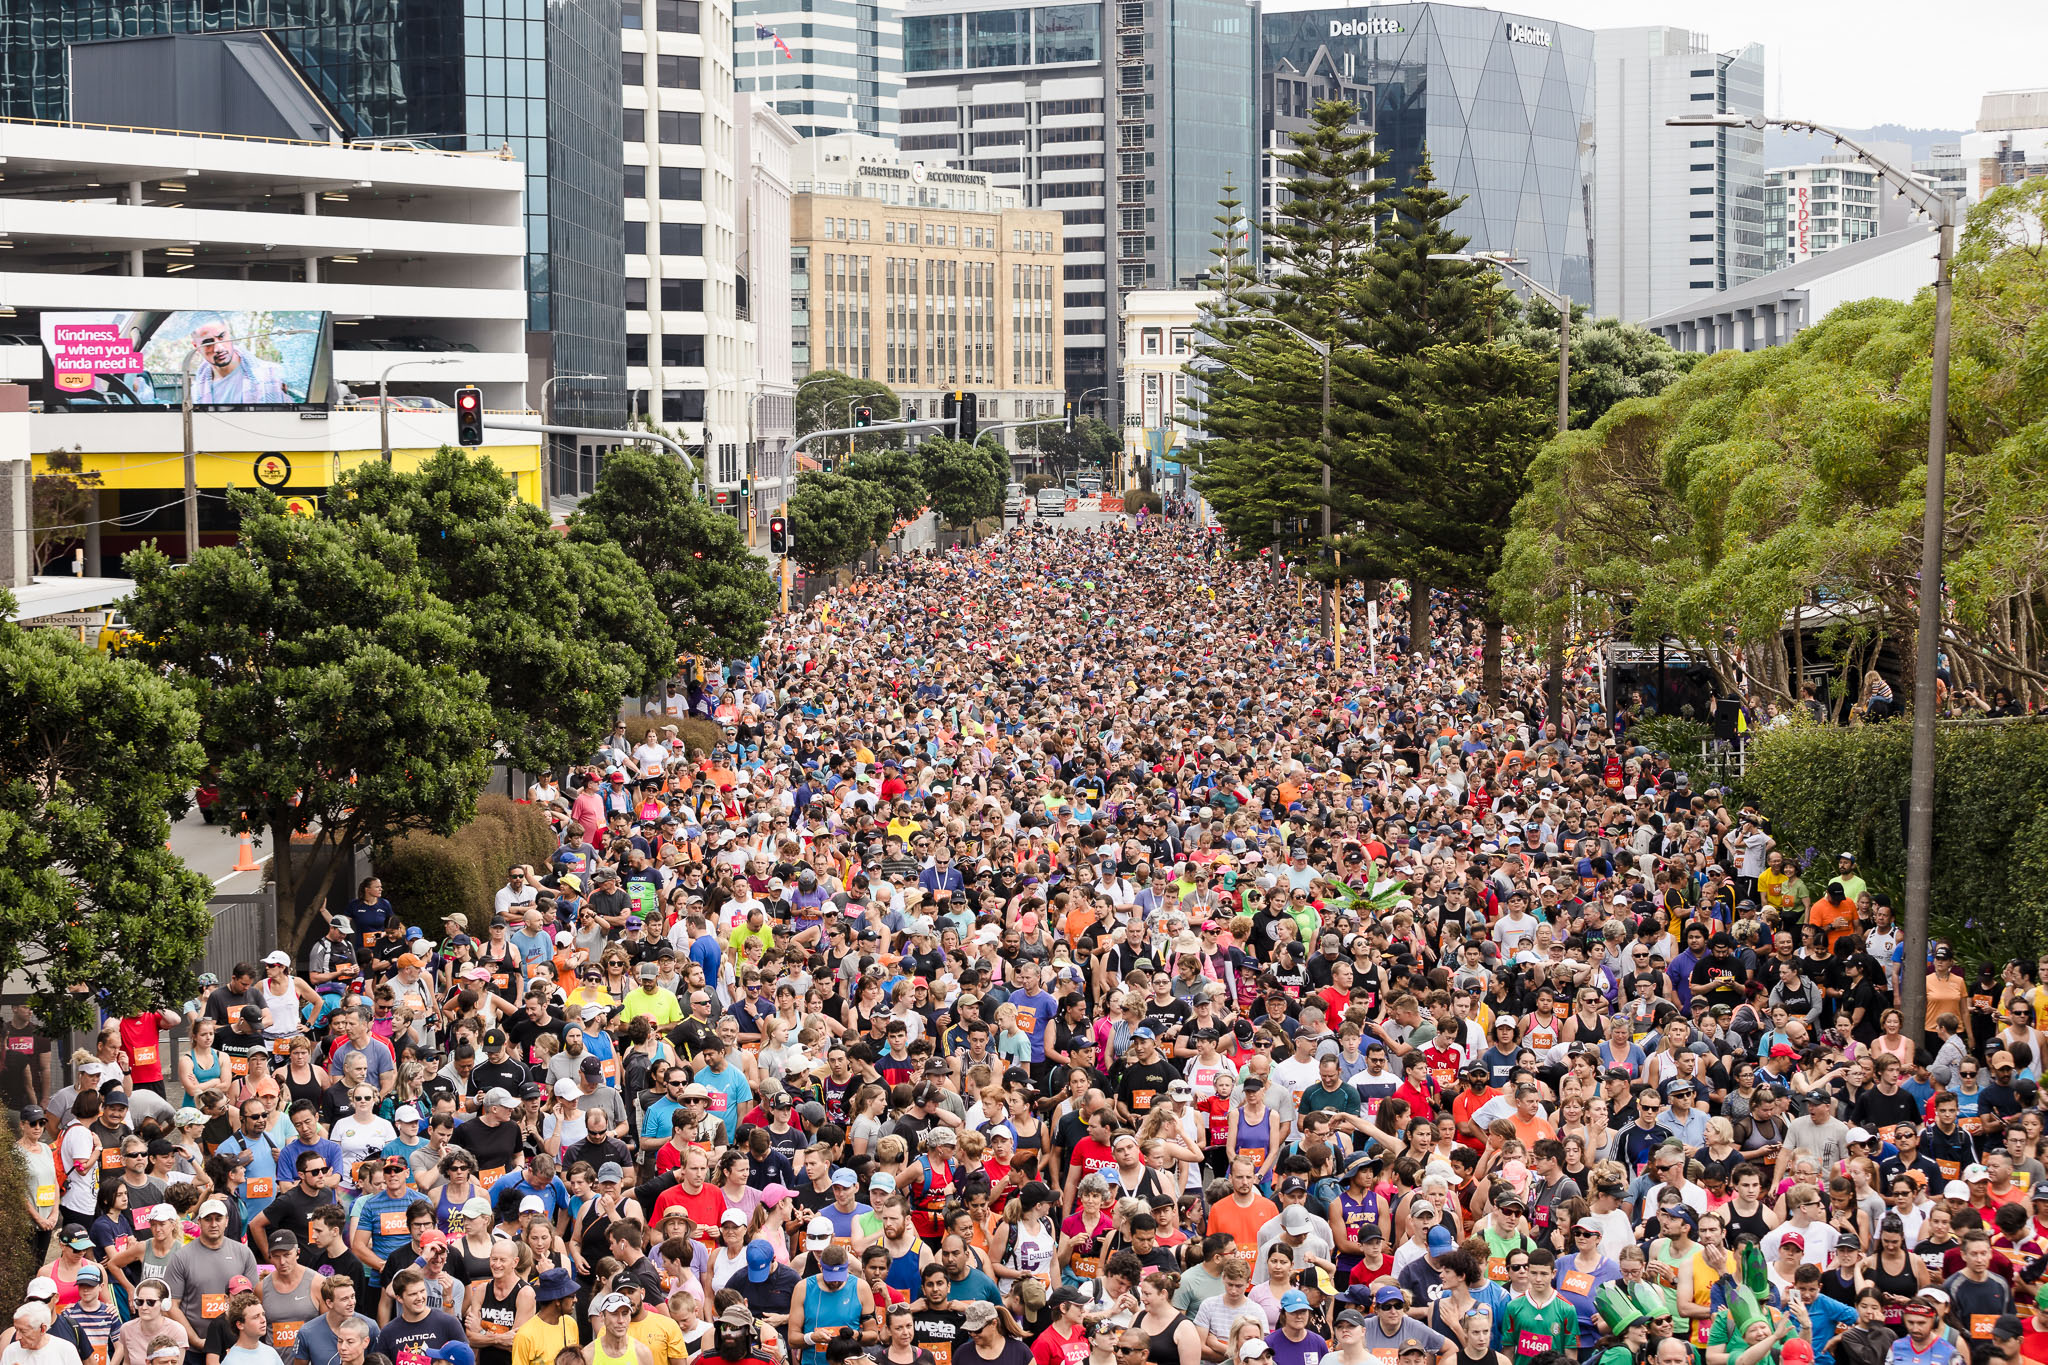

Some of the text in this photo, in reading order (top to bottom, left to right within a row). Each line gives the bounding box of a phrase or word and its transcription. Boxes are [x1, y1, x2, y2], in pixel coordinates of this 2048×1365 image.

[859, 165, 987, 186] CHARTERED ACCOUNTANTS
[1798, 187, 1809, 254] RYDGES
[57, 329, 116, 342] Kindness,
[67, 344, 131, 358] when you
[57, 357, 141, 369] kinda need it.
[32, 615, 92, 624] Barbershop
[529, 948, 541, 957] NIKE
[10, 1042, 33, 1050] 12254
[137, 1052, 155, 1061] 2821
[1198, 1074, 1214, 1082] 1010
[1085, 1158, 1120, 1171] OXYGEN
[253, 1184, 268, 1193] 663
[385, 1220, 408, 1230] 2602
[1075, 1261, 1096, 1274] 1436
[206, 1302, 229, 1312] 2249
[481, 1308, 514, 1320] weta
[915, 1320, 956, 1334] weta
[395, 1332, 437, 1344] NAUTICA
[929, 1331, 956, 1340] DIGITAL
[1521, 1339, 1549, 1353] 11460
[1066, 1349, 1090, 1362] 12333
